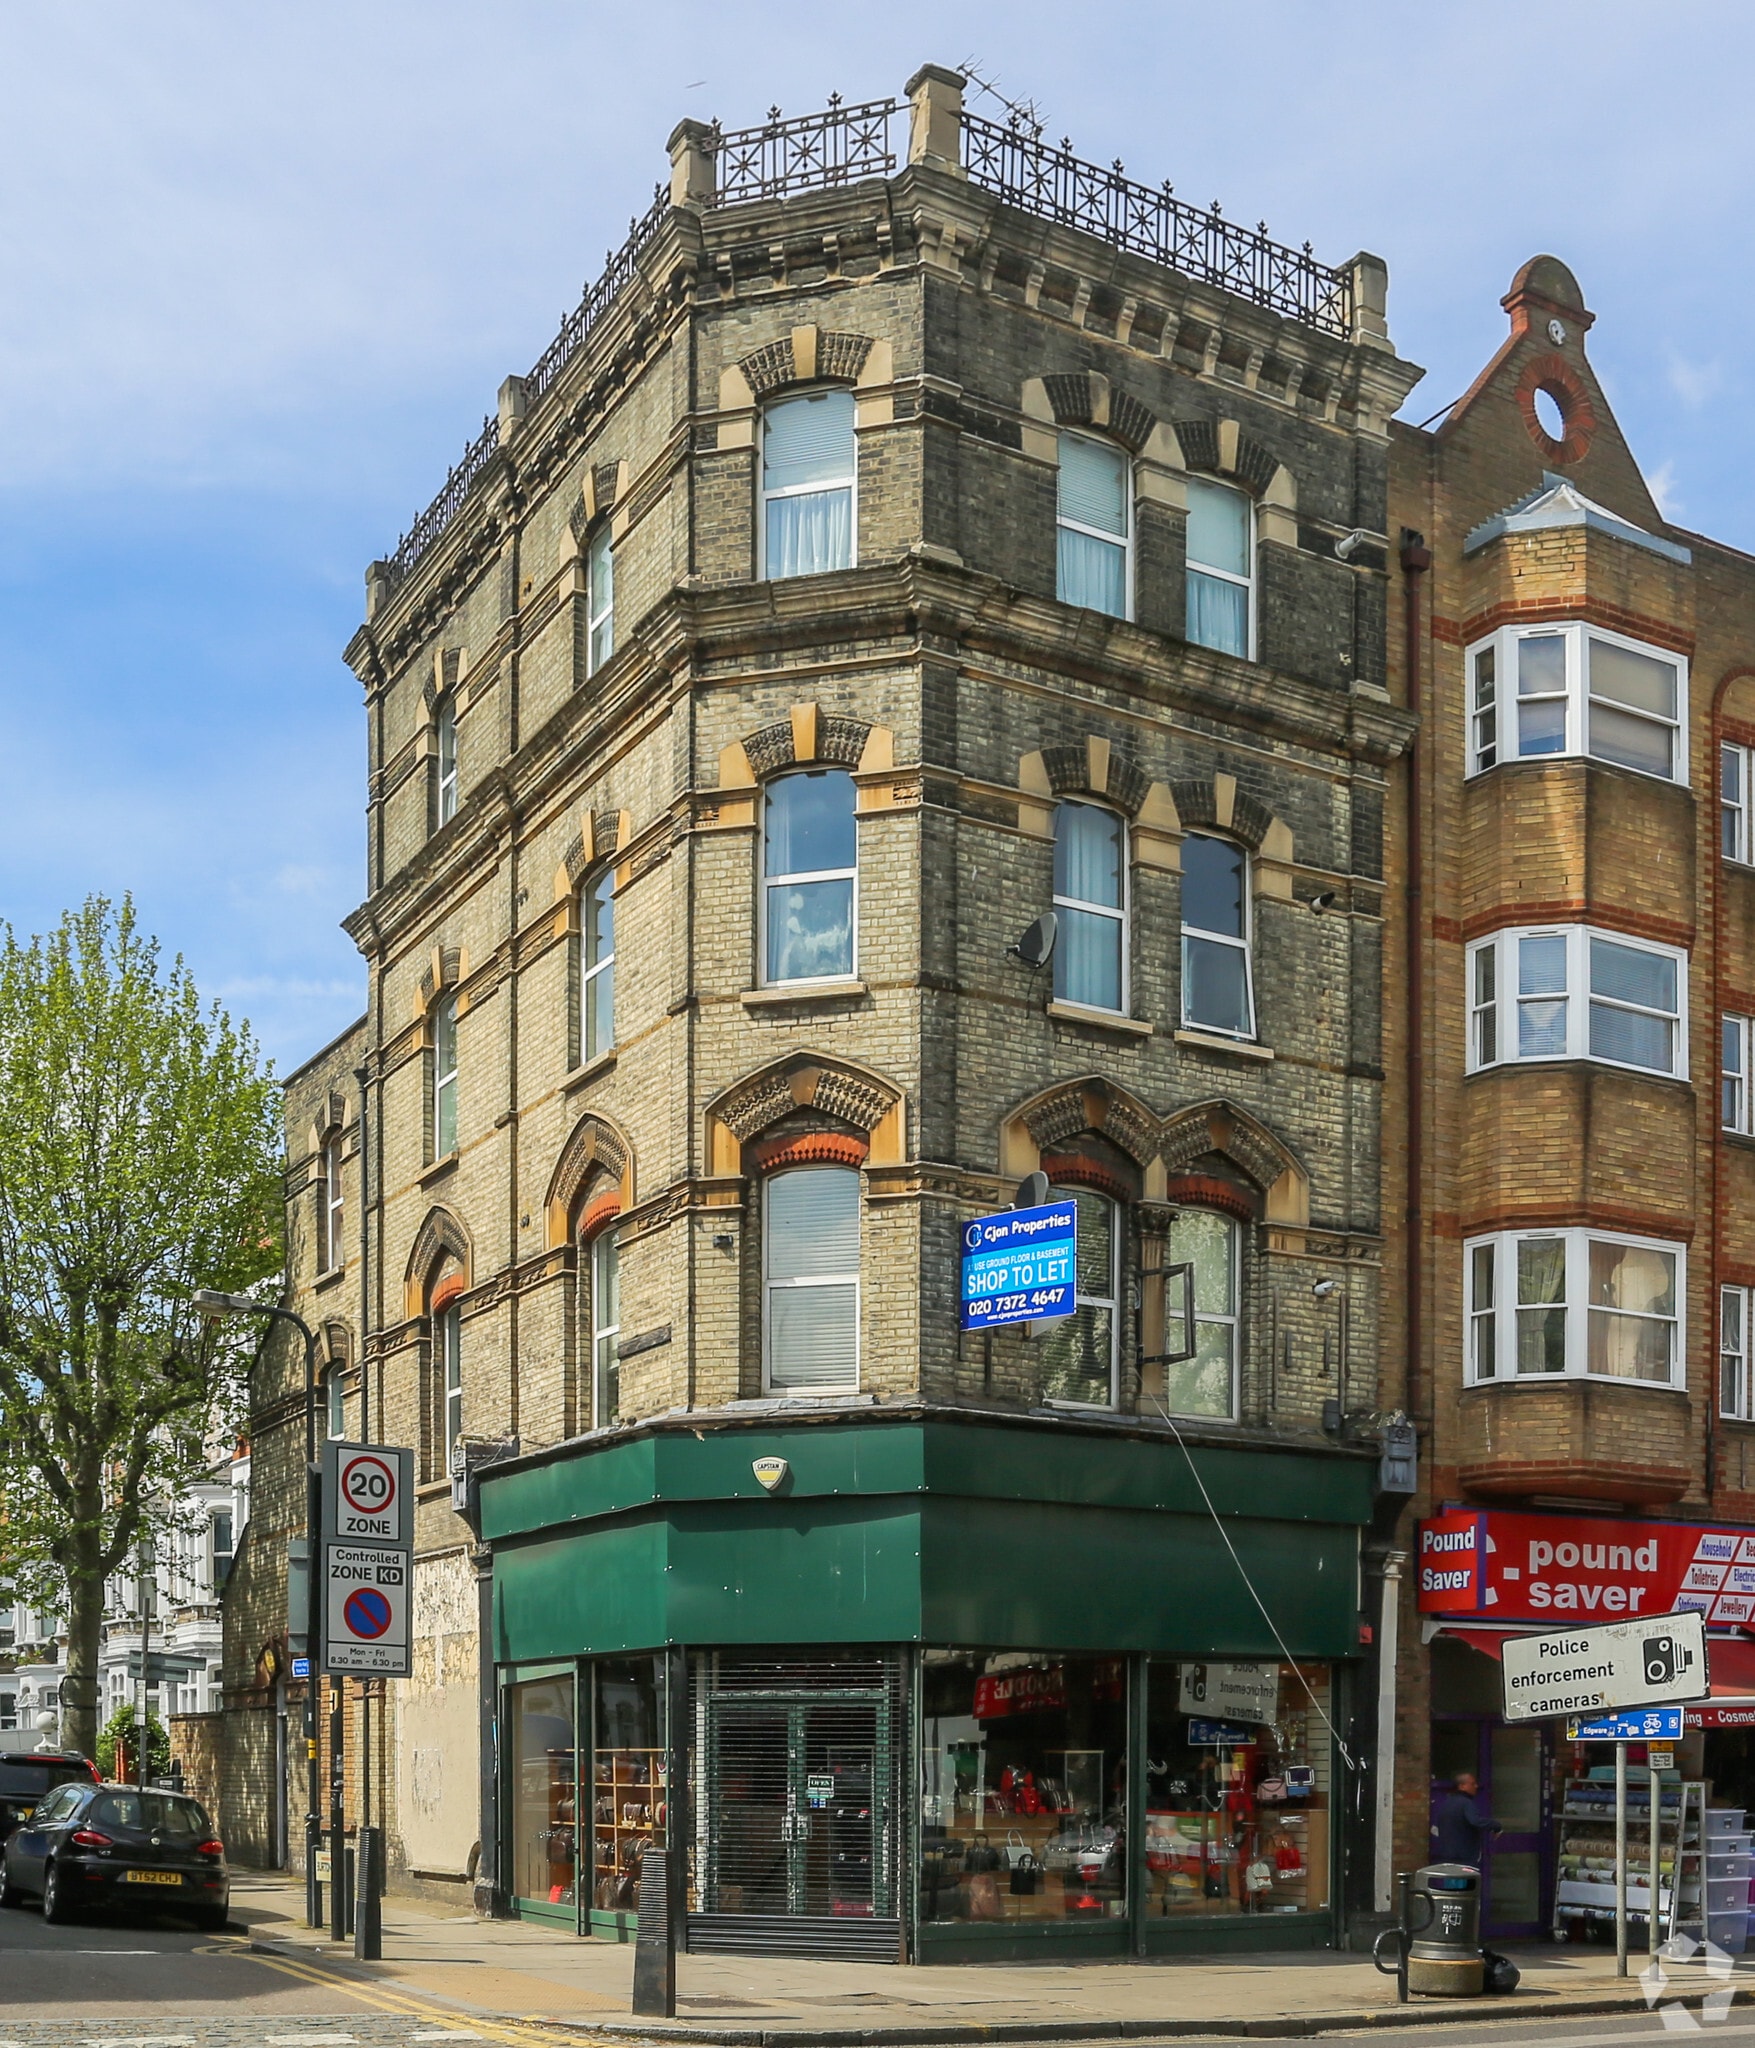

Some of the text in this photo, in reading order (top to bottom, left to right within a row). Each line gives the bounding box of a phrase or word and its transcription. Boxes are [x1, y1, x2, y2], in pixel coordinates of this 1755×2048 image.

[984, 1214, 1071, 1243] Cjon Properties
[974, 1260, 986, 1271] USE
[986, 1256, 1010, 1269] GROUND
[1010, 1253, 1031, 1265] FLOOR
[1031, 1251, 1036, 1261] &
[1036, 1246, 1069, 1260] BASEMENT
[967, 1259, 1069, 1295] SHOP TO LET
[968, 1288, 1065, 1316] 020 7372 4647
[350, 1472, 387, 1498] 20
[346, 1517, 391, 1535] ZONE
[1422, 1525, 1475, 1553] Pound
[1701, 1538, 1732, 1558] Household
[336, 1549, 400, 1565] Controlled
[1528, 1539, 1658, 1574] pound
[331, 1564, 401, 1583] ZONE KD
[1422, 1567, 1471, 1591] Saver
[1691, 1567, 1718, 1587] Toiletries
[1528, 1581, 1646, 1611] saver
[1720, 1596, 1748, 1620] Jewellery
[349, 1648, 366, 1656] Mon
[375, 1649, 386, 1657] Fri
[1539, 1639, 1589, 1658] Police
[330, 1656, 349, 1665] 8.30
[372, 1658, 390, 1666] 6.30
[1511, 1661, 1615, 1688] enforcement
[1530, 1693, 1600, 1713] cameras
[1684, 1711, 1703, 1727] ing
[1583, 1726, 1608, 1736] Edgware
[131, 1871, 178, 1883] BT52 CHJ
